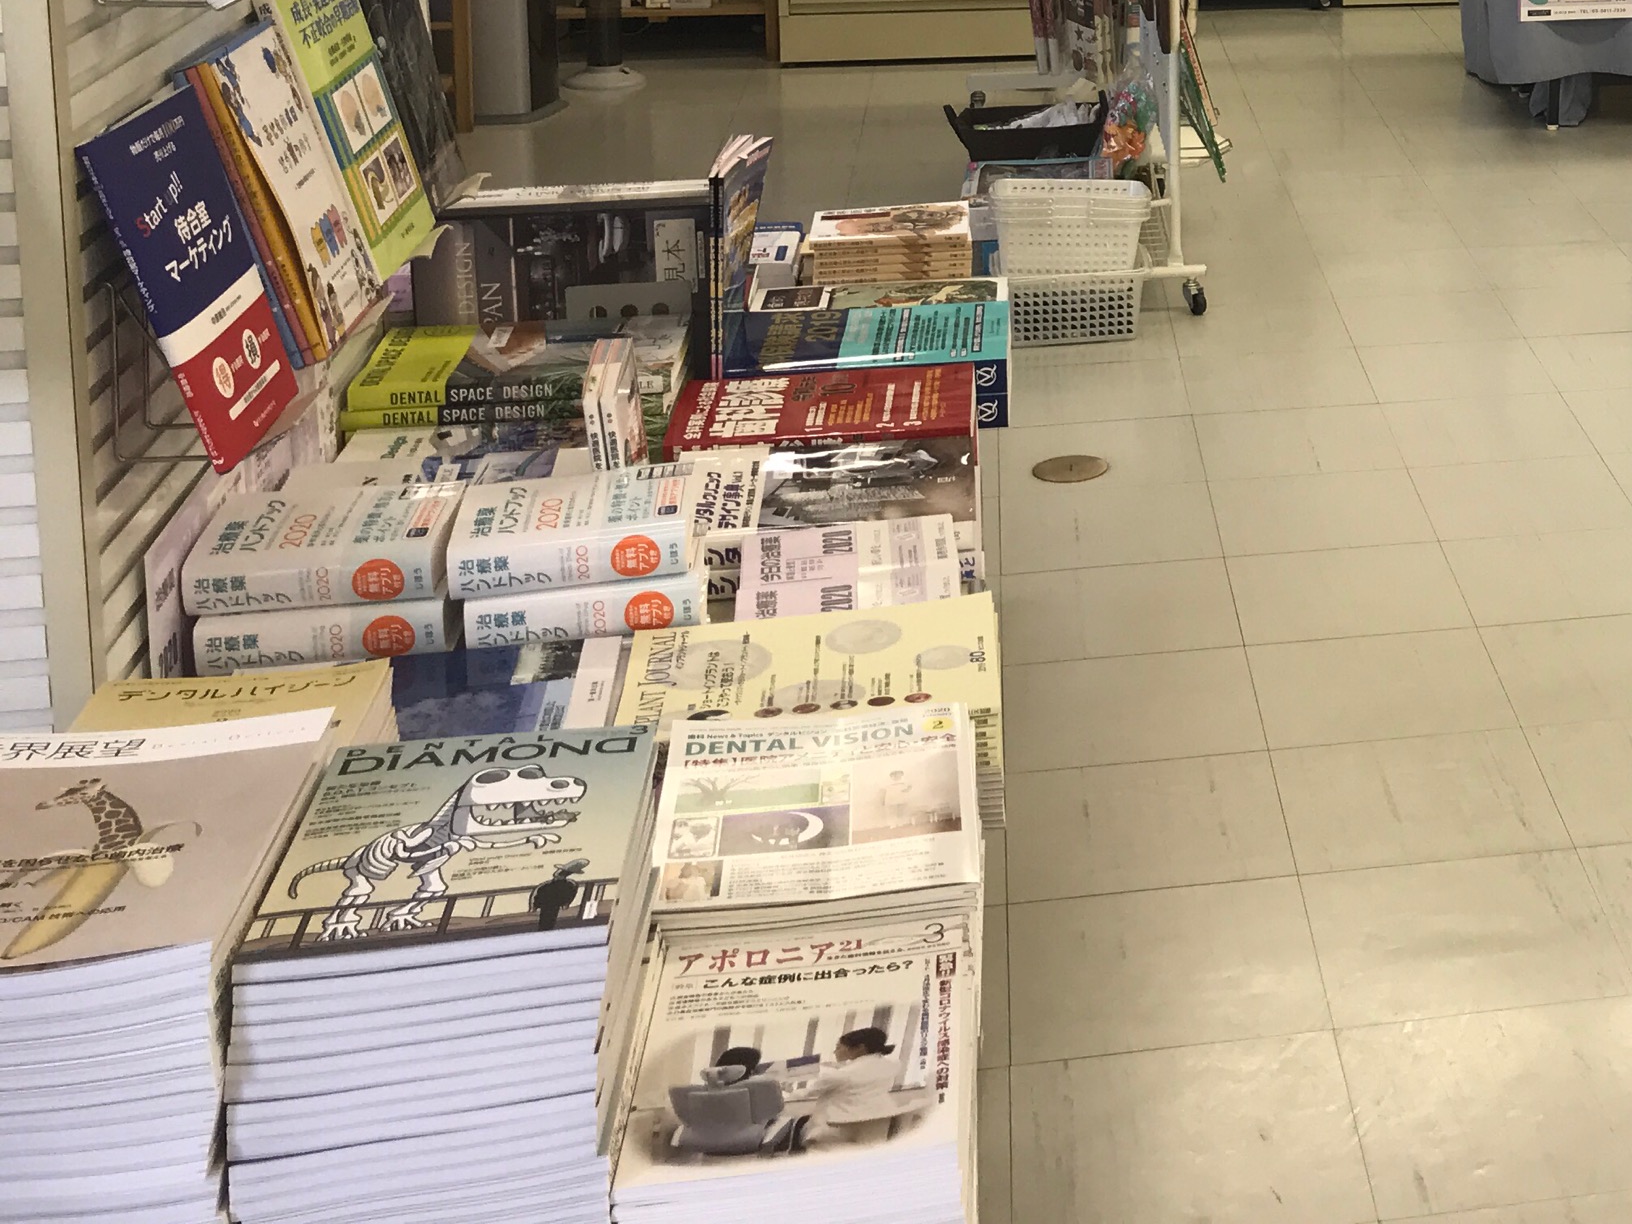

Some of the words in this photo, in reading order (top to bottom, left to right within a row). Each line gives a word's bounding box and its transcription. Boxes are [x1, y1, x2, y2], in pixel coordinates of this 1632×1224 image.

[136, 197, 168, 238] Start
[174, 200, 212, 245] 待合室
[164, 215, 234, 283] マーケティング
[455, 242, 475, 316] DESIGN
[805, 310, 841, 342] 2019
[390, 391, 441, 405] DENTAL
[450, 386, 493, 402] SPACE
[502, 382, 553, 398] DESIGN
[383, 410, 433, 426] DENTAL
[442, 406, 485, 422] SPACE
[495, 404, 545, 421] DESIGN
[709, 377, 790, 438] 歯科診療
[497, 487, 528, 533] ハンドブック
[535, 498, 564, 530] 2020
[239, 499, 286, 553] ハンドブック
[279, 513, 317, 550] 2020
[669, 542, 679, 566] じほう
[822, 529, 853, 554] 2020
[458, 556, 509, 577] 治療薬
[577, 545, 589, 580] 2020
[625, 544, 638, 569] 無料
[638, 541, 651, 570] アプリ
[760, 535, 781, 583] 今日の治療薬
[192, 575, 247, 595] 治療薬
[318, 566, 329, 601] 2020
[460, 571, 553, 593] ハンドブック
[194, 590, 292, 611] ハンドブック
[651, 598, 664, 625] アプリ
[683, 598, 693, 622] じほう
[820, 585, 853, 612] 2020
[476, 610, 527, 631] 治療薬
[592, 600, 605, 634] 2020
[639, 600, 652, 625] 無料
[205, 633, 260, 655] 治療薬
[330, 624, 342, 659] 2020
[477, 624, 568, 647] ハンドブック
[207, 650, 305, 676] ハンドブック
[645, 630, 677, 687] JOURNAL
[118, 676, 356, 701] デンタルハイジーン
[631, 724, 649, 737] 3
[932, 720, 945, 729] 2
[0, 737, 147, 761] 界展望
[347, 733, 555, 758] DENTAL
[684, 736, 805, 757] DENTAL
[812, 724, 914, 747] VISION
[337, 736, 638, 777] DIAMOND
[923, 922, 945, 944] 3
[678, 939, 863, 975] アポロニア21
